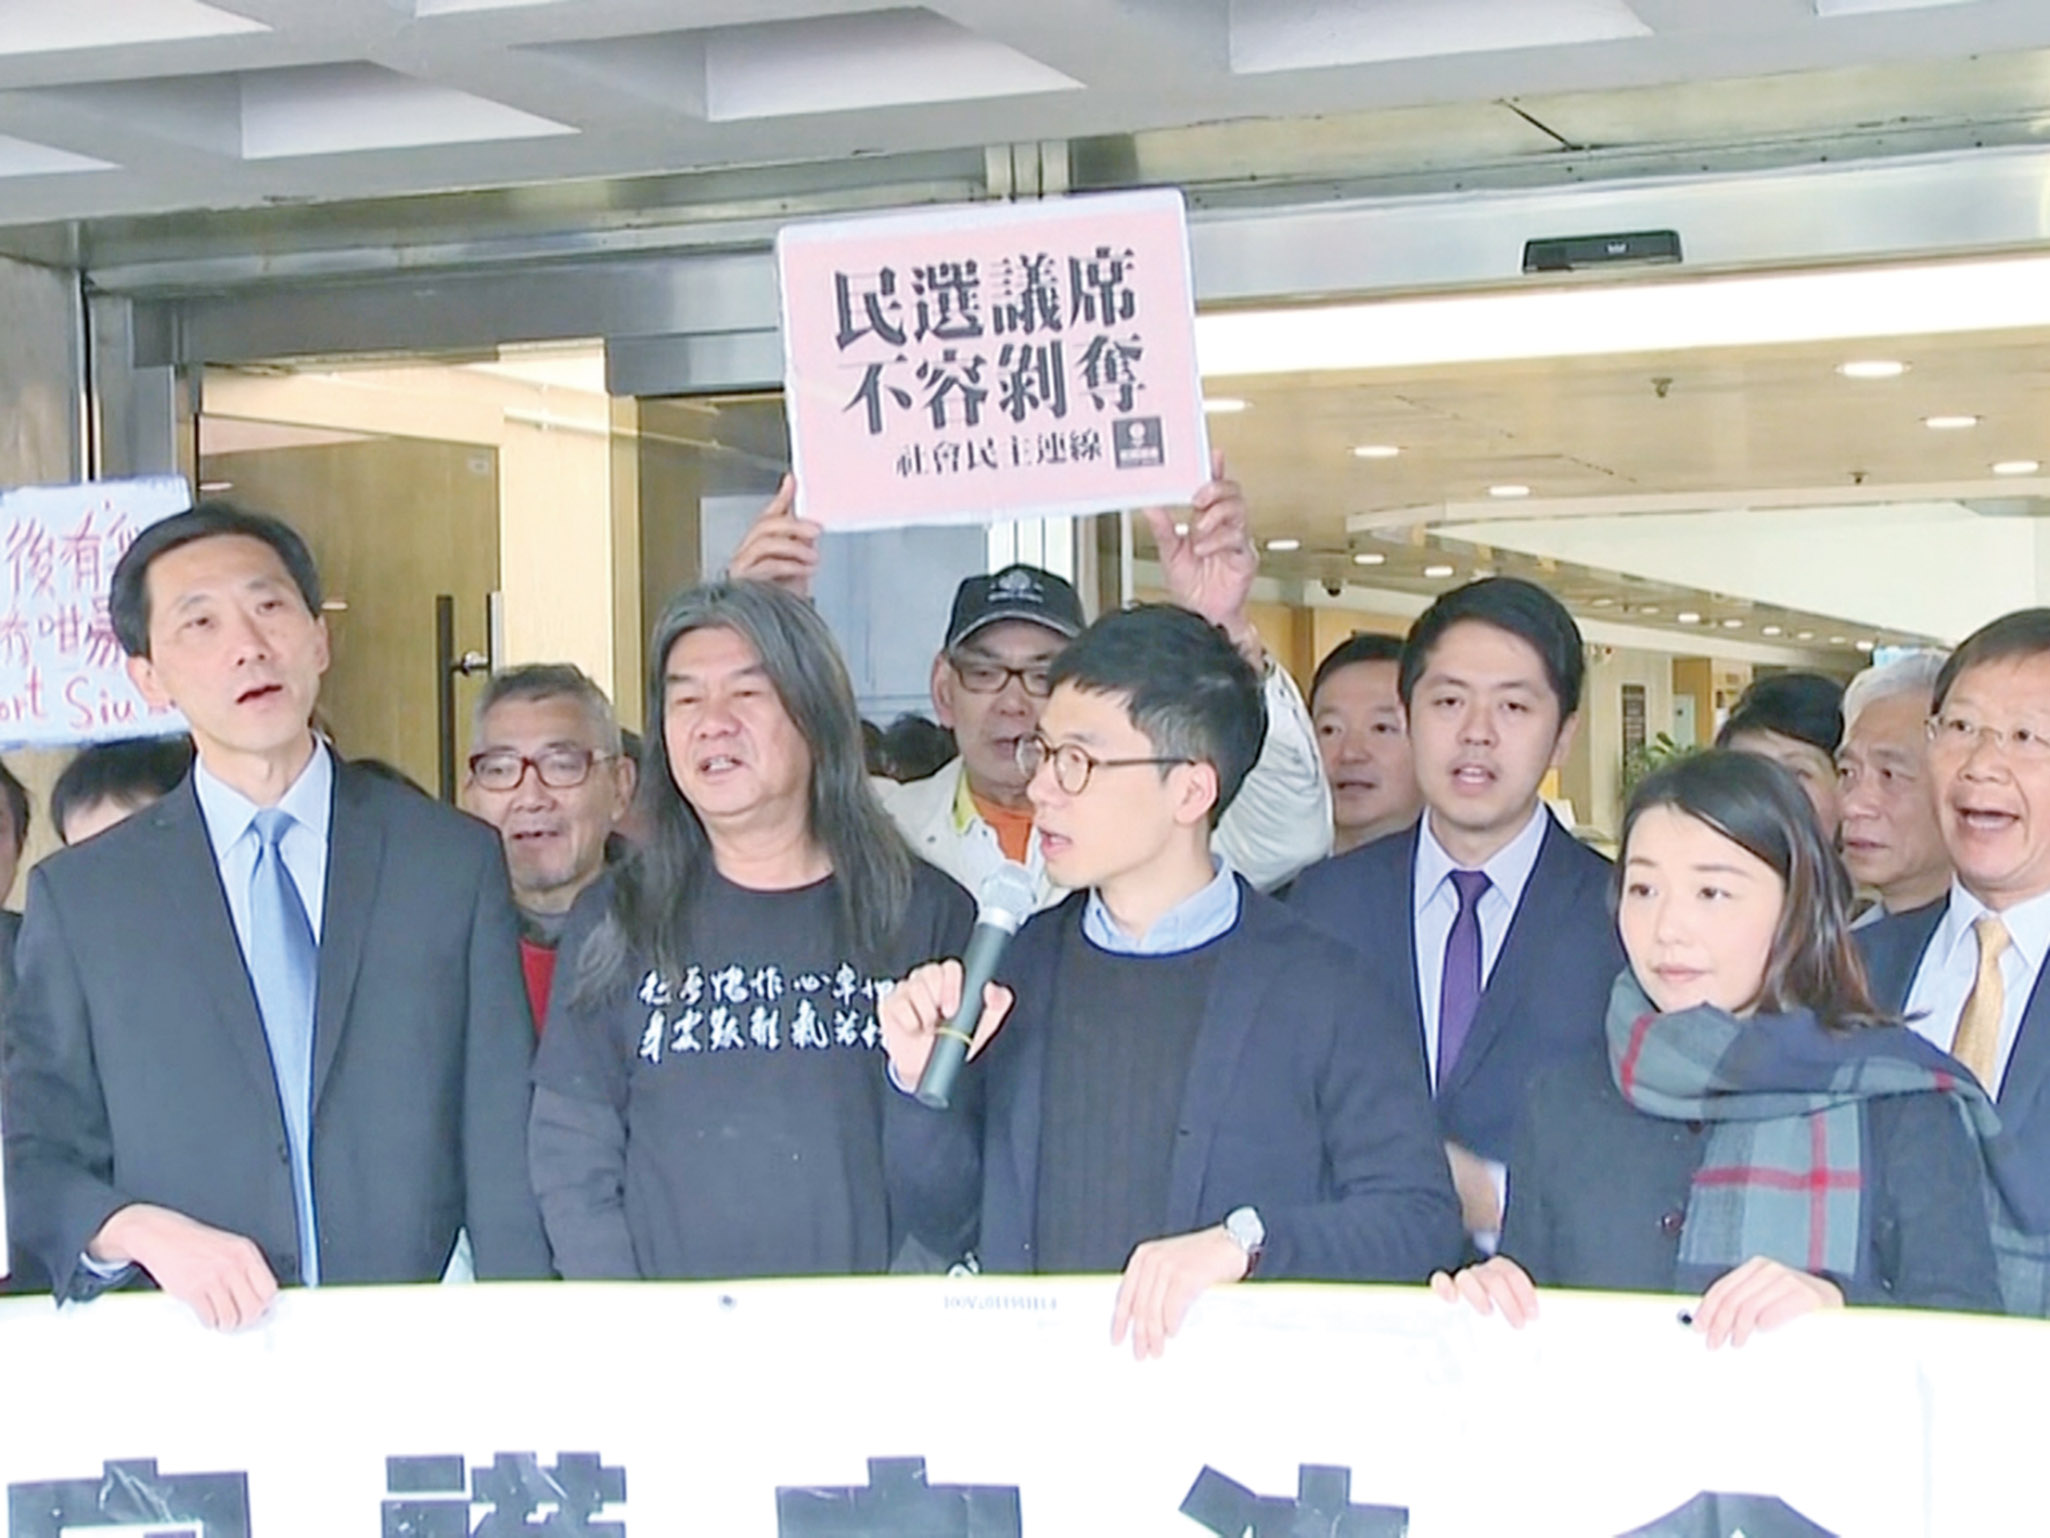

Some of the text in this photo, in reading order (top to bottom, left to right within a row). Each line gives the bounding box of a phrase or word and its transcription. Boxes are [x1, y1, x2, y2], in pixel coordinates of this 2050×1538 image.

[834, 247, 1140, 351] 民選議席
[838, 333, 1147, 435] 不容剝奪
[895, 428, 1103, 478] 社會民主連線
[65, 675, 136, 730] Siu
